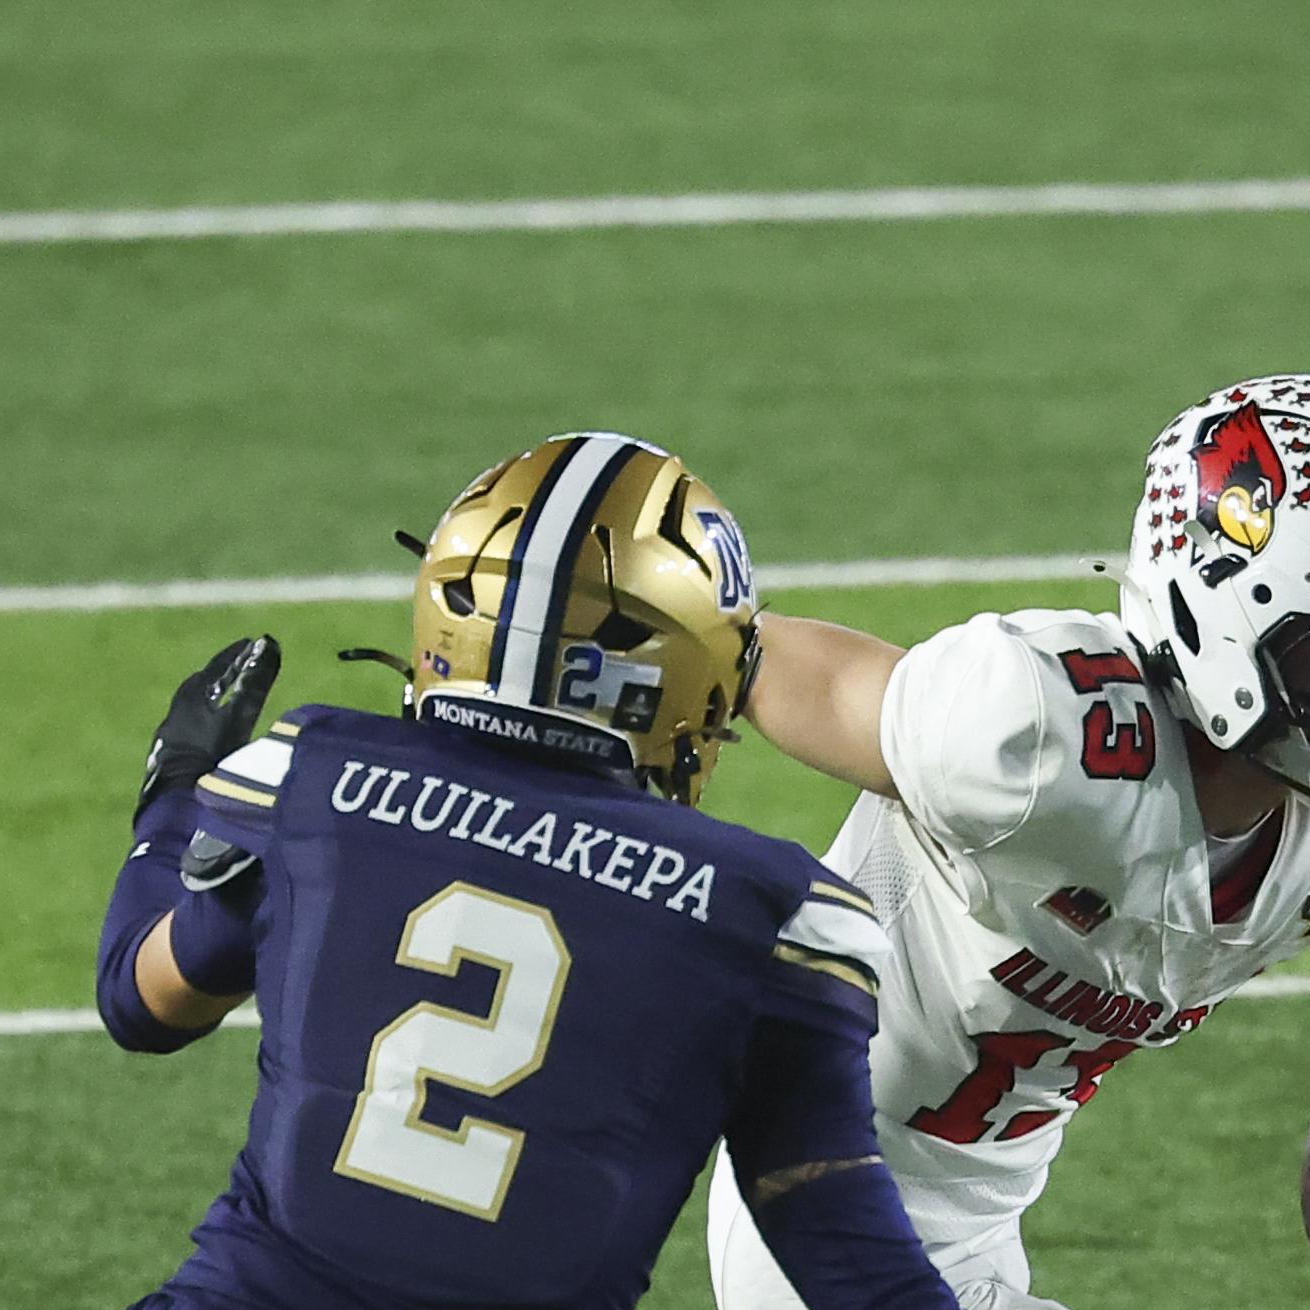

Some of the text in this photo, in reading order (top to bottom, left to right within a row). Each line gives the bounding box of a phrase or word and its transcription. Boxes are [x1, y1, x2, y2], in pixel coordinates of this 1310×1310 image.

[433, 700, 614, 757] MONTANA STATE
[555, 641, 606, 711] 2
[1056, 647, 1156, 781] 13
[331, 761, 717, 922] ULUILAKEPA
[988, 947, 1164, 1040] ILLINOIS
[332, 880, 572, 1222] 2
